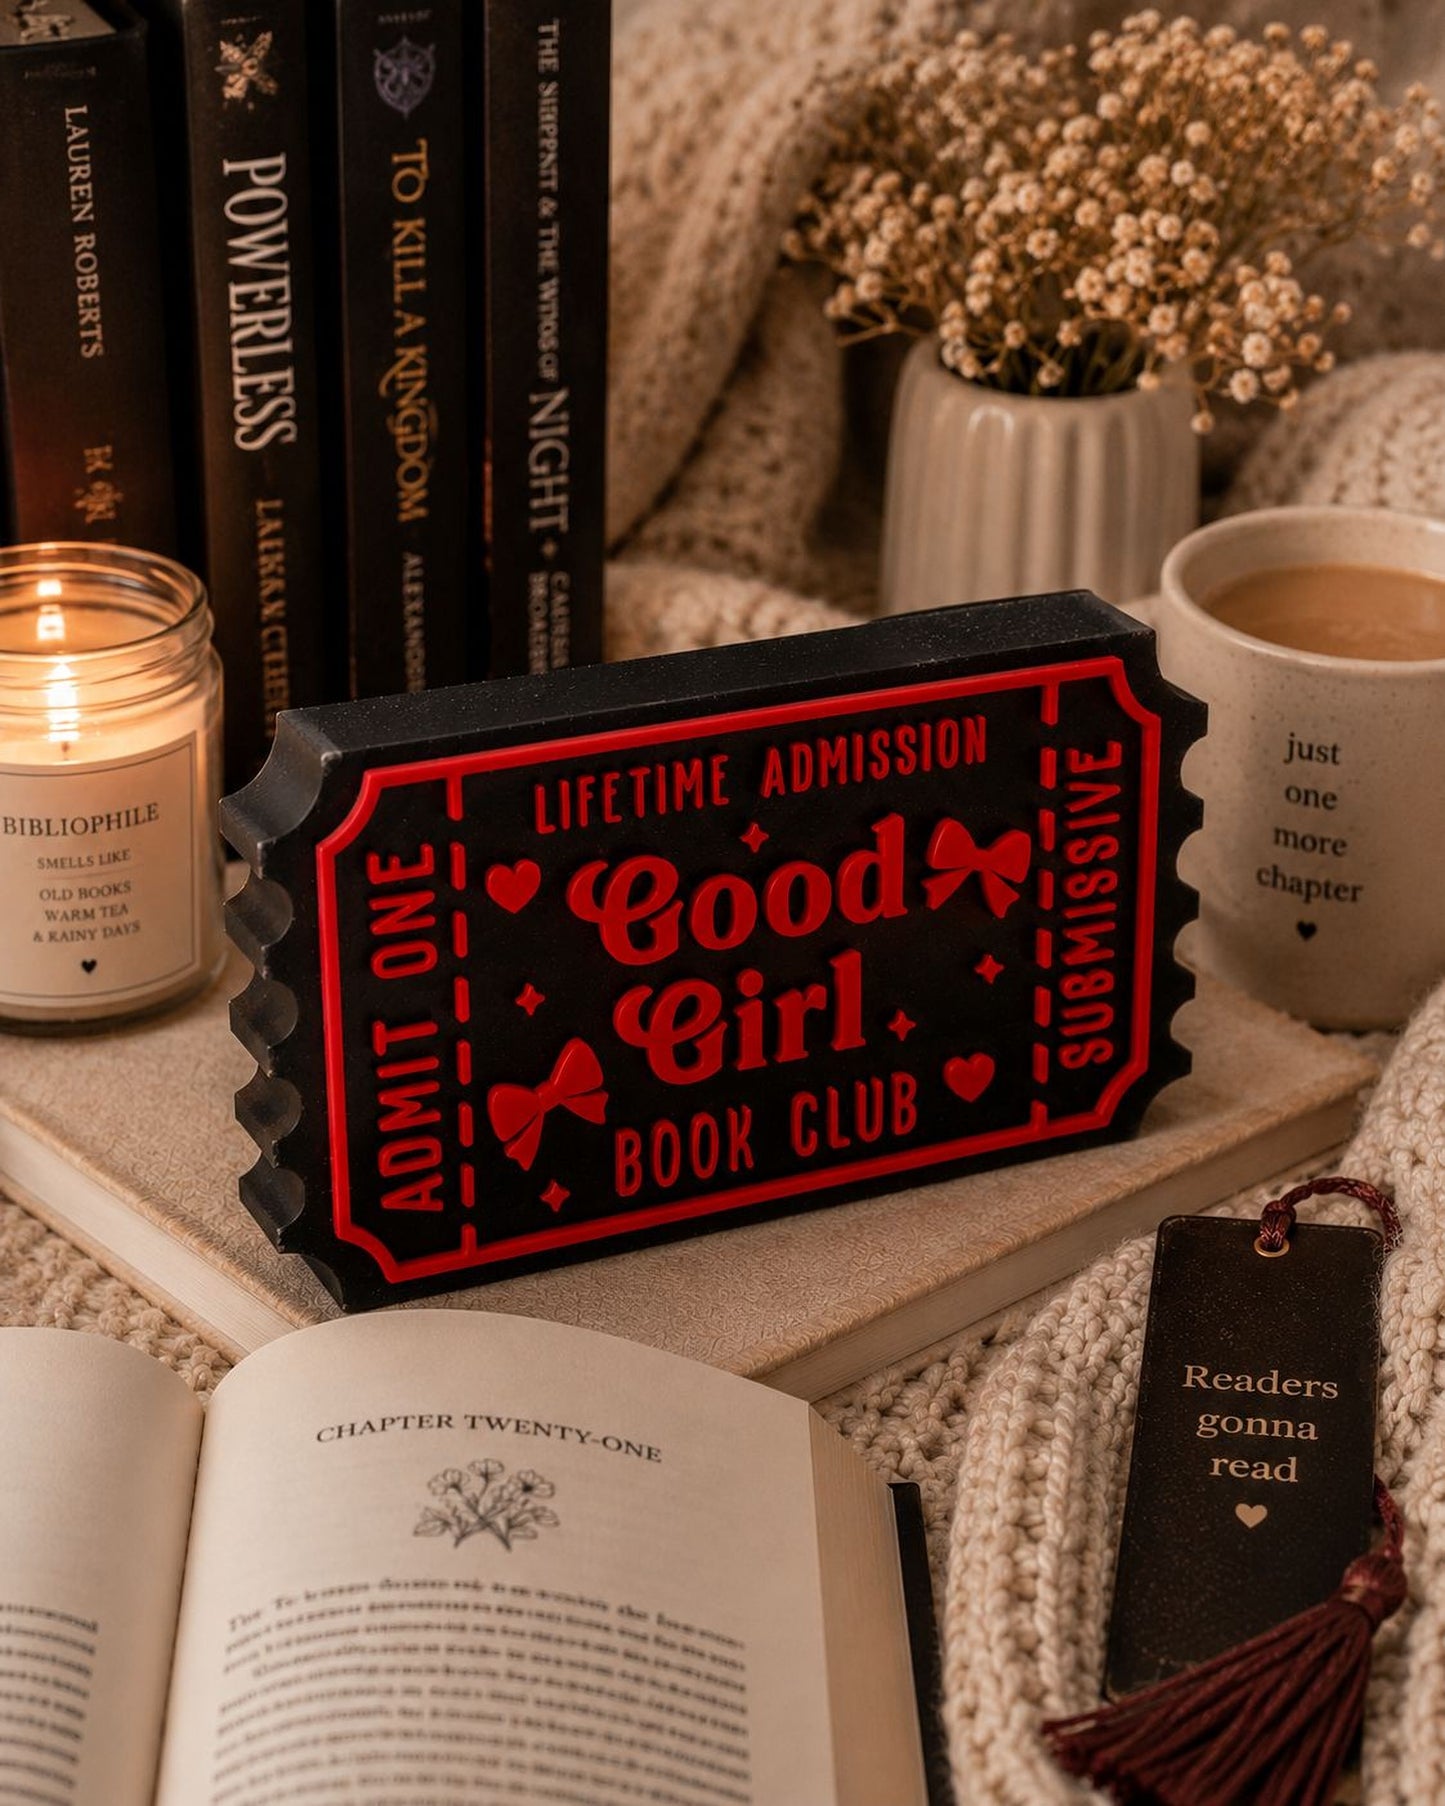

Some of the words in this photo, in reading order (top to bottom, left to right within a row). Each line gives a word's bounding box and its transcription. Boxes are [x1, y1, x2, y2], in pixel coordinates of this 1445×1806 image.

[536, 18, 560, 74] THE
[64, 105, 95, 223] LAUREN
[391, 138, 430, 203] TO
[391, 217, 428, 305] KILL
[73, 234, 104, 360] ROBERTS
[222, 152, 298, 452] POWERLESS
[394, 308, 428, 338] A
[378, 344, 438, 522] KINGDOM
[528, 387, 571, 534] NIGHT
[534, 755, 730, 836] LIFETIME
[760, 715, 988, 799] ADMISSION
[1283, 732, 1342, 765] just
[3, 802, 160, 837] BIBLIOPHILE
[1284, 785, 1339, 811] one
[37, 855, 95, 870] SMELLS
[98, 848, 131, 866] LIKE
[1273, 827, 1348, 857] more
[39, 888, 74, 901] OLD
[78, 881, 132, 901] BOOKS
[366, 843, 439, 980] ONE
[566, 812, 909, 966] Good
[1058, 740, 1123, 1069] SUBMISSIVE
[1256, 864, 1364, 904] chapter
[33, 931, 44, 943] &
[49, 927, 98, 943] RAINY
[102, 920, 141, 939] DAYS
[45, 908, 96, 922] WARM
[99, 903, 129, 918] TEA
[613, 949, 866, 1085] Girl
[372, 1019, 445, 1212] ADMIT
[615, 1105, 755, 1197] BOOK
[791, 1071, 918, 1158] CLUB
[1182, 1364, 1339, 1400] Readers
[316, 1414, 455, 1444] CHAPTER
[464, 1414, 662, 1464] TWENTY-ONE
[1196, 1413, 1319, 1441] gonna
[1208, 1456, 1299, 1484] read
